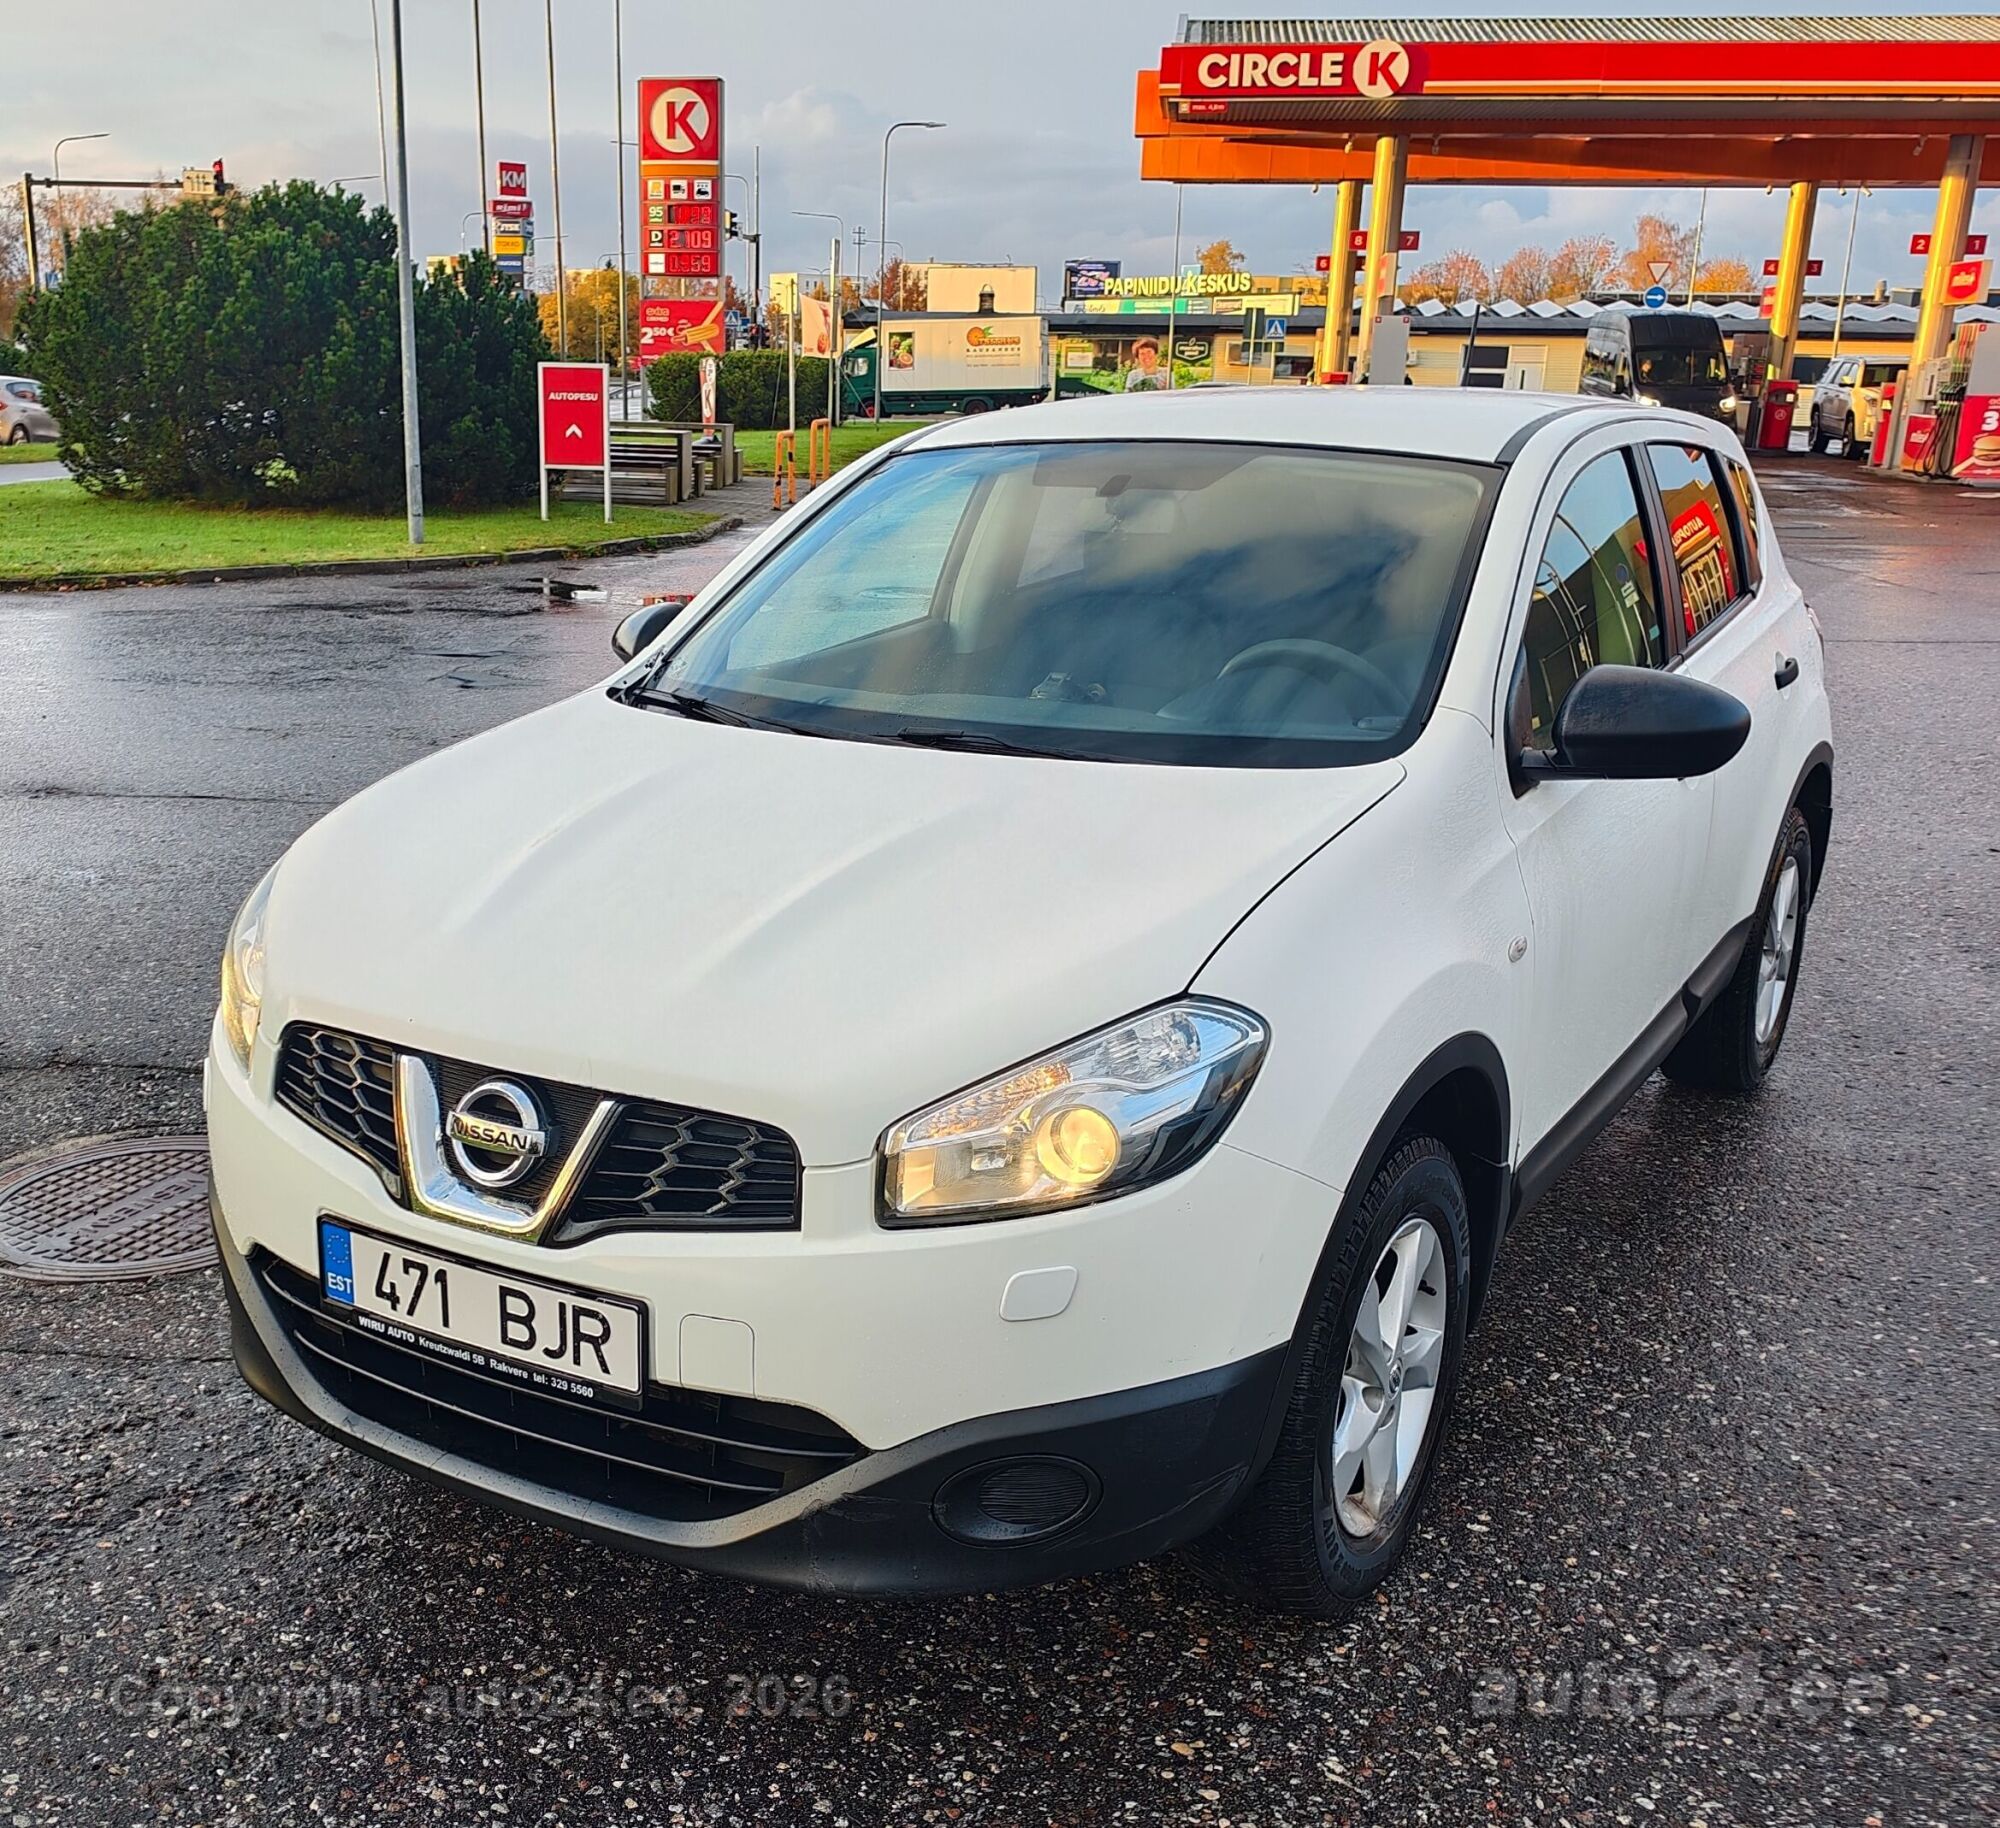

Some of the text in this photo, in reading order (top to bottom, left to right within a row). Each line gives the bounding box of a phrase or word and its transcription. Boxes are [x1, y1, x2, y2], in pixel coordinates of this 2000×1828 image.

[1198, 51, 1401, 93] CIRCLE K
[666, 101, 703, 147] K
[502, 170, 525, 189] KM
[649, 206, 663, 217] 95
[651, 231, 662, 242] D
[1354, 236, 1363, 246] 8
[1406, 236, 1414, 246] 7
[1916, 239, 1925, 249] 2
[1973, 240, 1980, 249] 1
[1320, 259, 1327, 268] 6
[1767, 263, 1775, 272] 4
[1812, 263, 1818, 272] 3
[1104, 275, 1181, 296] PAPINIIDU
[1187, 272, 1251, 294] KESKUS
[548, 392, 598, 401] AUTOPESU
[453, 1115, 528, 1150] NISSAN
[327, 1271, 353, 1294] EST
[375, 1252, 611, 1375] 471 BJR
[358, 1315, 594, 1398] WIRU AUTO Kreutzwaldi 5B Rakvere tel: 329 5560
